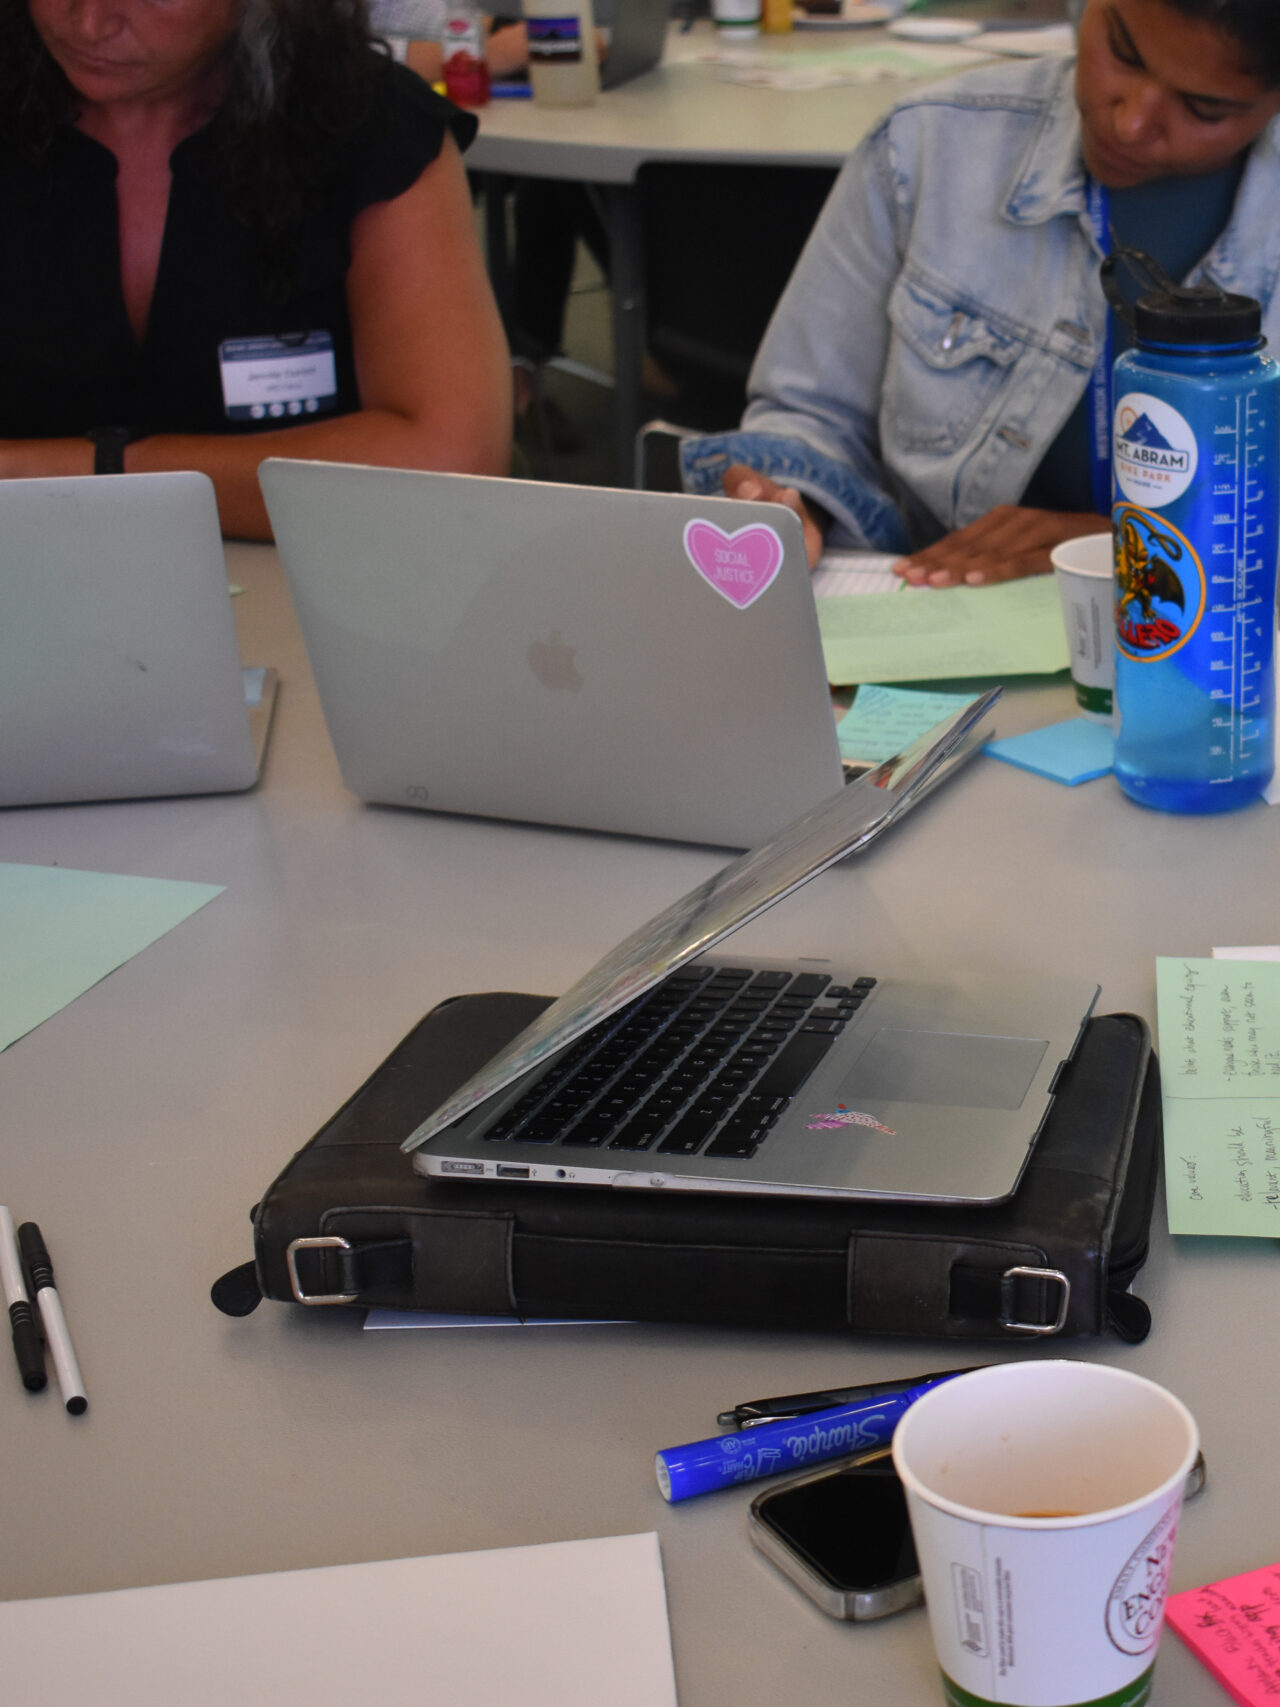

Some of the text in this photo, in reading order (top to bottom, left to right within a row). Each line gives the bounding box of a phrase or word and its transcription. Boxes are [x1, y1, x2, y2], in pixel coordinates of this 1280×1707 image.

[1133, 448, 1184, 468] ABRAM
[1142, 470, 1171, 483] PARK
[714, 549, 750, 567] SOCIAL
[713, 567, 758, 584] JUSTICE
[1244, 992, 1255, 1008] seem
[1179, 995, 1196, 1031] educational
[1244, 1010, 1256, 1023] not
[1246, 1027, 1264, 1042] may
[1224, 1126, 1252, 1202] education should be
[786, 1414, 886, 1461] Sharpie
